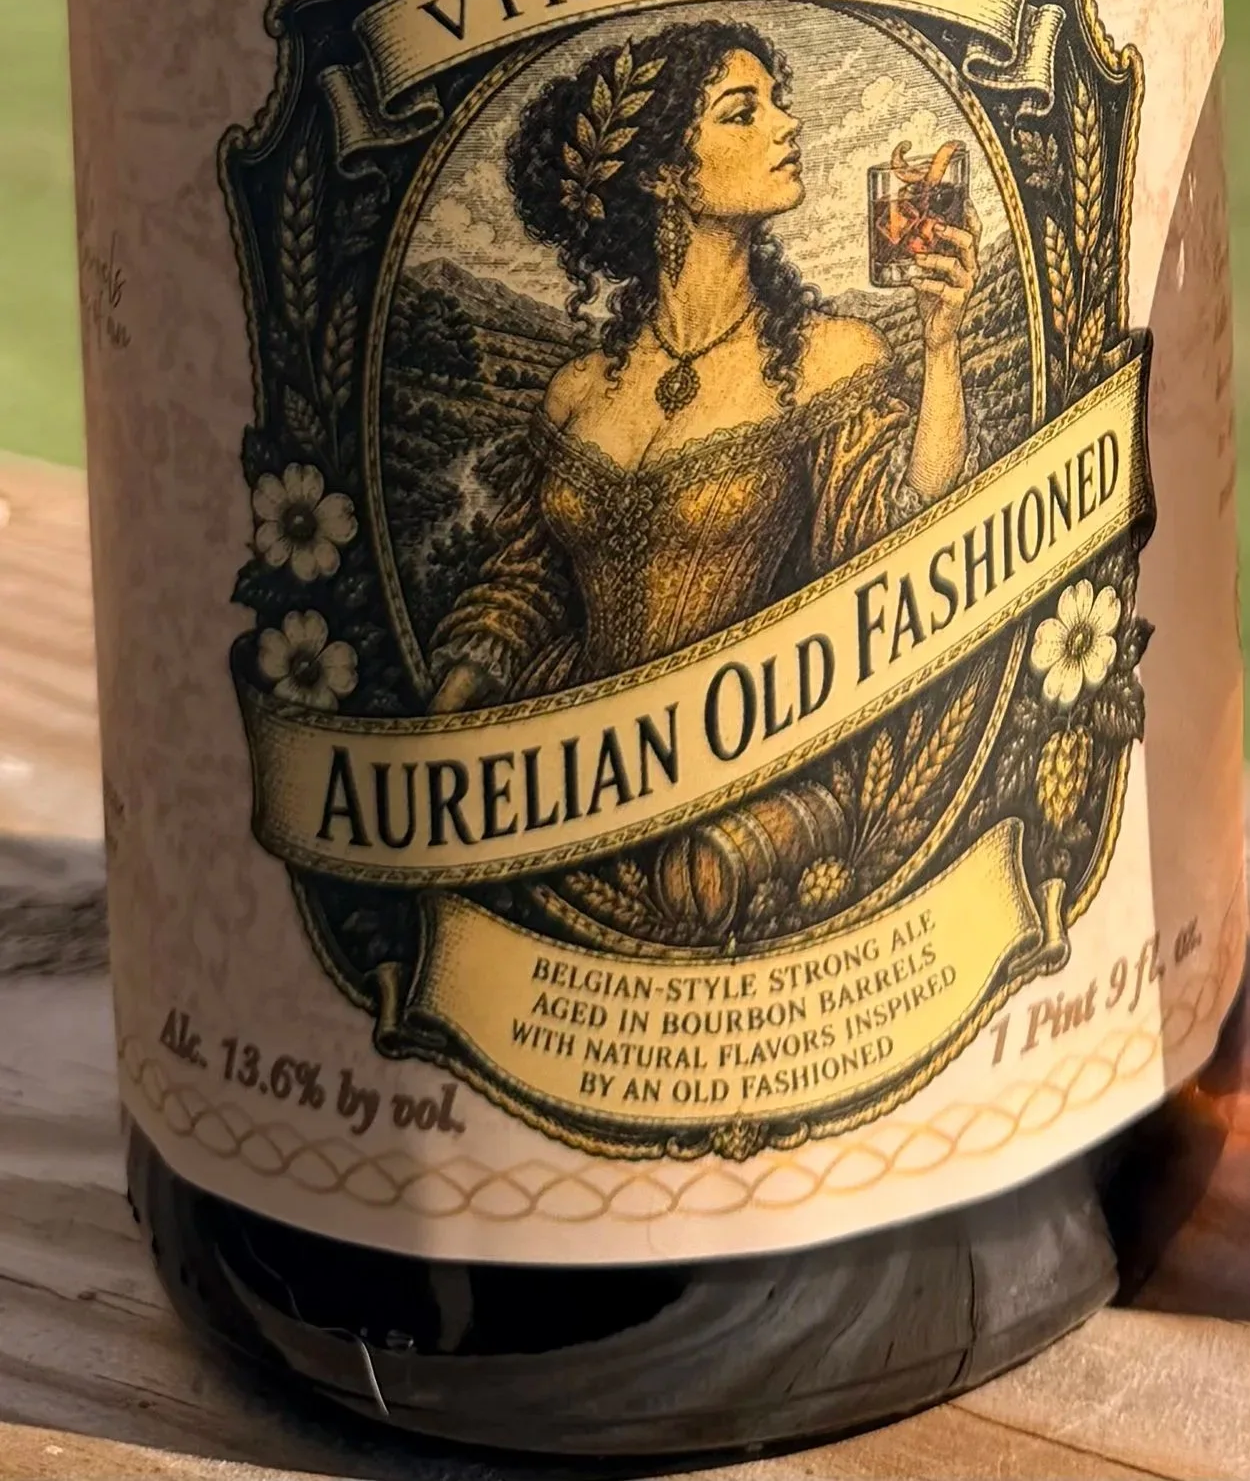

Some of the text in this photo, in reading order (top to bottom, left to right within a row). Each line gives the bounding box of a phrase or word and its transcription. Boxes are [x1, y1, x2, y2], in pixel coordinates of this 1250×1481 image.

[317, 430, 1120, 848] AURELIAN OLD FASHIONED
[531, 909, 937, 1002] BELGIAN-STYLE STRONG ALE
[531, 942, 937, 1036] AGED IN BOURBON BARRELS
[990, 1013, 1011, 1067] 1
[1020, 978, 1097, 1059] Pint
[1105, 955, 1128, 1009] 9
[1128, 931, 1166, 1013] fl.
[512, 964, 957, 1069] WITH NATURAL FLAVORS INSPIRED
[580, 1035, 894, 1103] BY AN OLD FASHIONED
[160, 1007, 466, 1135] Alc. 13.6% by vol.
